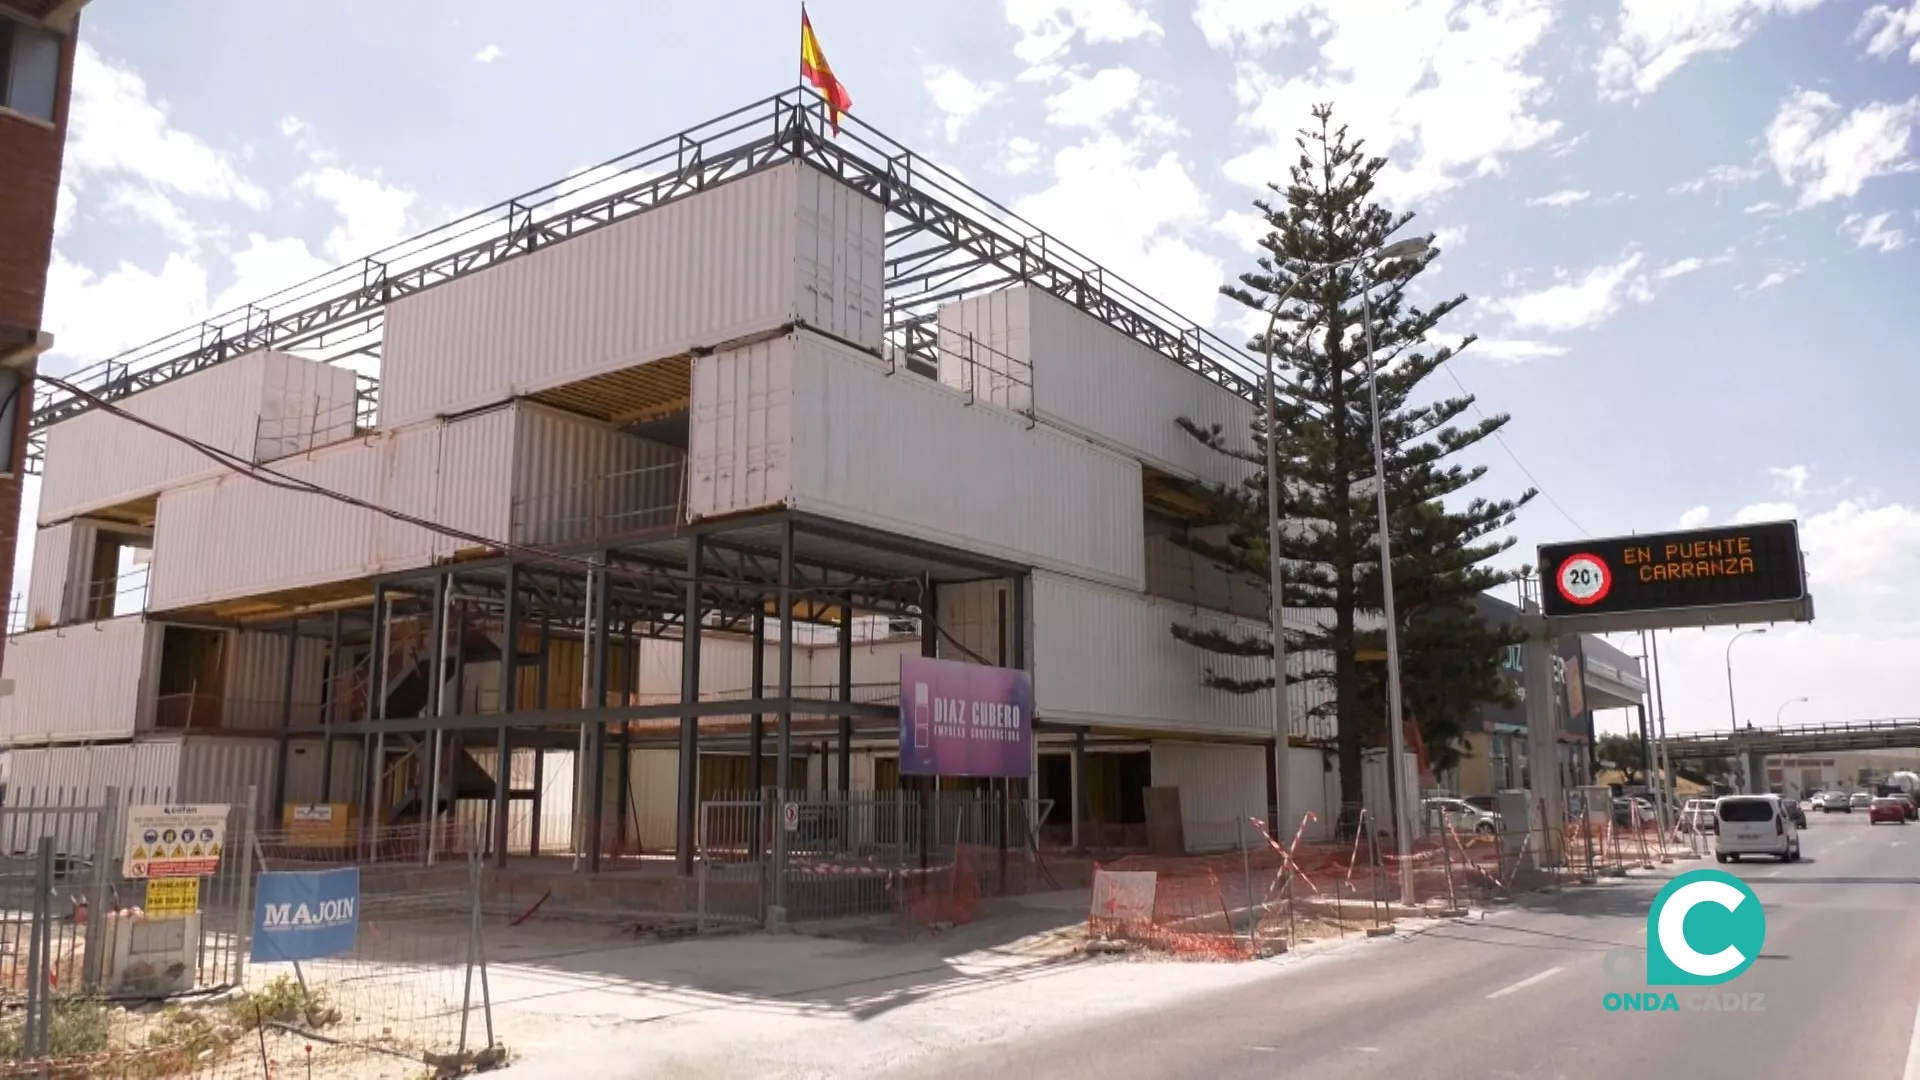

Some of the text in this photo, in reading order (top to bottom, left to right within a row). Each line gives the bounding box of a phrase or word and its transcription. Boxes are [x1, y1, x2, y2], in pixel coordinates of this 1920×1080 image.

[1624, 537, 1752, 564] EN PUENTE
[1570, 568, 1591, 586] 20
[1640, 557, 1754, 582] CARRANZA
[972, 701, 1020, 729] CUBERO
[263, 897, 355, 926] MAJOIN
